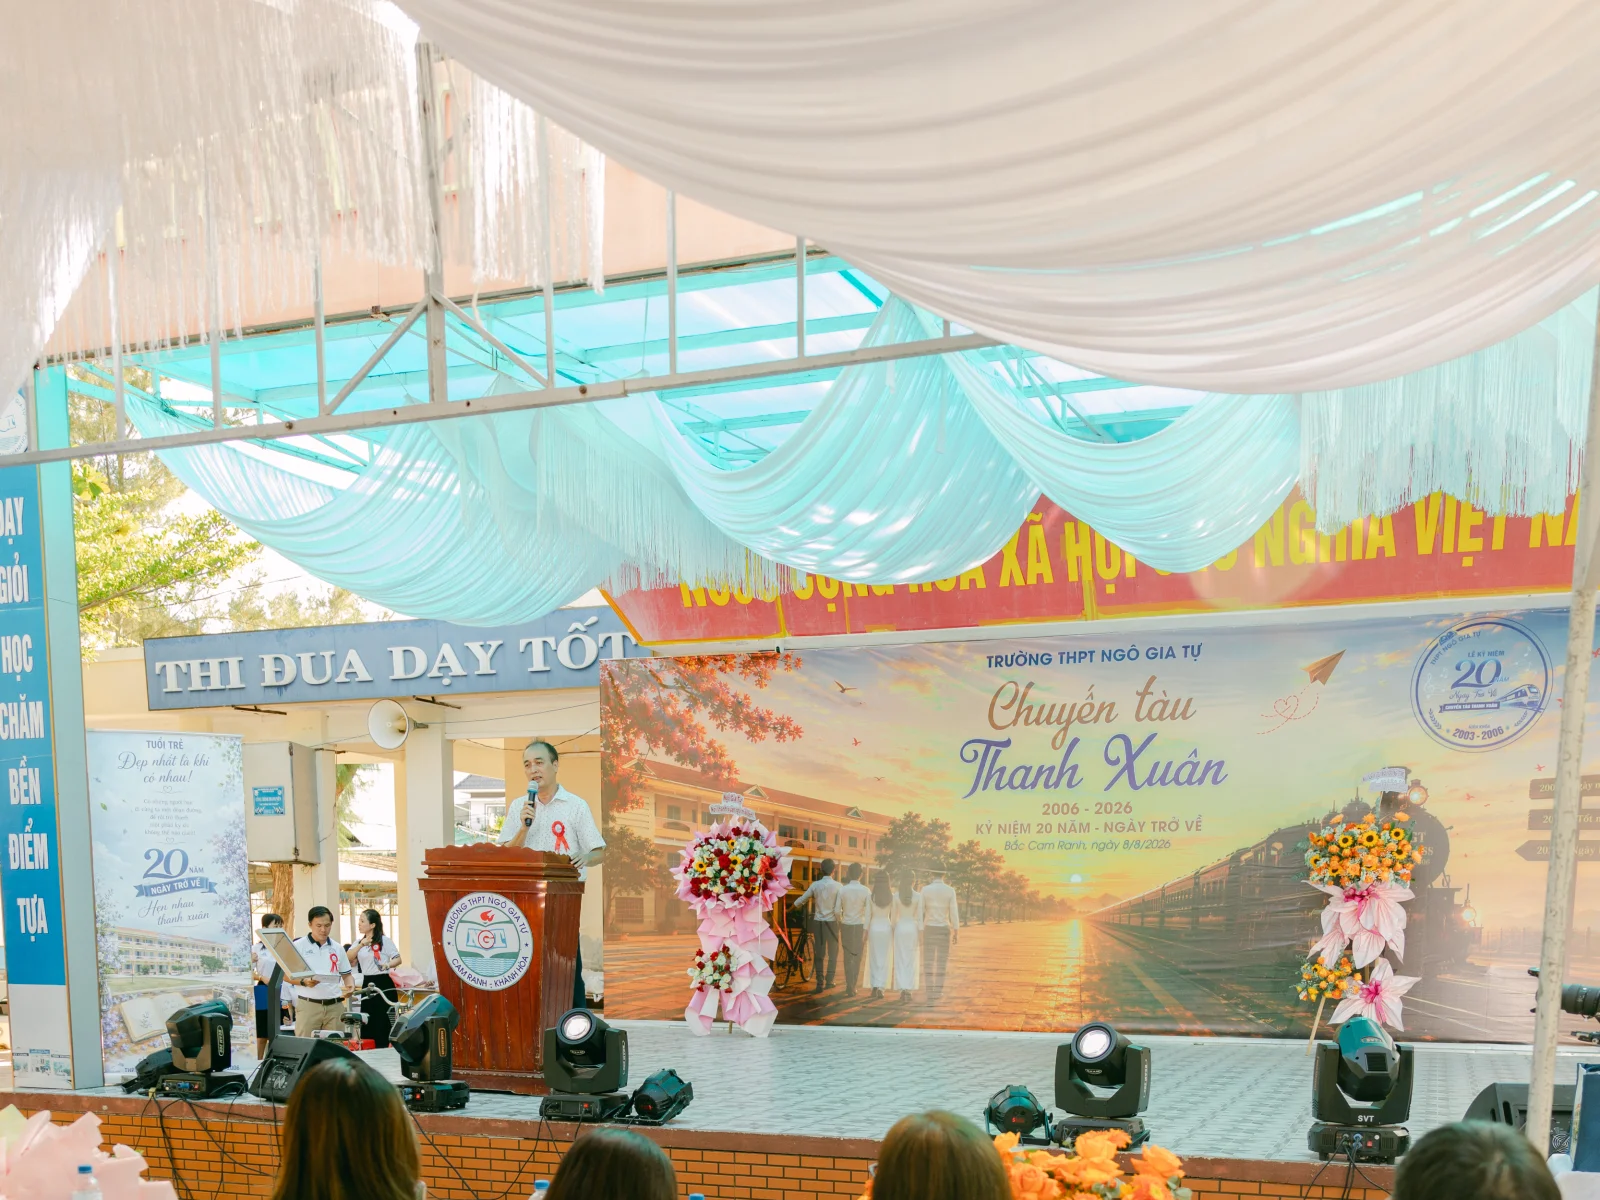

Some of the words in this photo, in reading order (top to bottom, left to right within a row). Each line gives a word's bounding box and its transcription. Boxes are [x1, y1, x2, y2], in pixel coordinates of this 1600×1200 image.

[1, 634, 33, 682] HỌC
[155, 656, 246, 693] THI
[260, 648, 373, 686] ĐUA
[387, 639, 503, 686] DẠY
[519, 615, 638, 672] TỐT
[986, 650, 1053, 669] TRƯỜNG
[1058, 650, 1096, 665] THPT
[1101, 644, 1140, 663] NGÔ
[1145, 645, 1176, 660] GIA
[1182, 643, 1203, 662] TỰ
[1451, 658, 1502, 690] 20
[0, 694, 45, 740] CHĂM
[987, 681, 1119, 750] Chuyến
[1135, 675, 1197, 723] tàu
[146, 737, 166, 749] TUỔI
[168, 738, 184, 750] TRẺ
[1452, 728, 1475, 741] 2003
[1481, 726, 1505, 740] 2006
[118, 751, 149, 771] Đẹp
[180, 754, 189, 767] là
[193, 753, 209, 767] khi
[959, 737, 1084, 800] Thanh
[1103, 732, 1228, 792] Xuân
[143, 772, 155, 783] có
[159, 770, 193, 783] nhau!
[1540, 784, 1555, 792] 200
[1042, 803, 1080, 816] 2006
[1094, 802, 1133, 815] 2026
[975, 819, 993, 835] KỶ
[997, 817, 1031, 838] NIỆM
[1036, 822, 1053, 834] 20
[1057, 819, 1091, 834] NĂM
[1104, 817, 1145, 834] NGÀY
[1150, 817, 1180, 833] TRỞ
[1185, 814, 1203, 832] VỀ
[8, 817, 49, 870] ĐIỂM
[1004, 838, 1027, 851] Bắc
[1028, 840, 1055, 851] Cam
[1057, 840, 1087, 850] Ranh,
[1090, 840, 1120, 852] ngày
[1123, 839, 1171, 851] 8/8/2026
[143, 848, 189, 879] 20
[151, 884, 171, 896] NGÀY
[173, 880, 189, 890] TRỞ
[16, 894, 48, 942] TỰA
[138, 900, 167, 919] Hẹn
[171, 897, 195, 910] nhau
[157, 911, 183, 926] thanh
[187, 911, 210, 921] xuân
[468, 896, 485, 907] THPT
[508, 907, 521, 922] GIA
[451, 958, 468, 976] CAM
[466, 973, 488, 987] RANH
[1357, 1114, 1375, 1122] SVT
